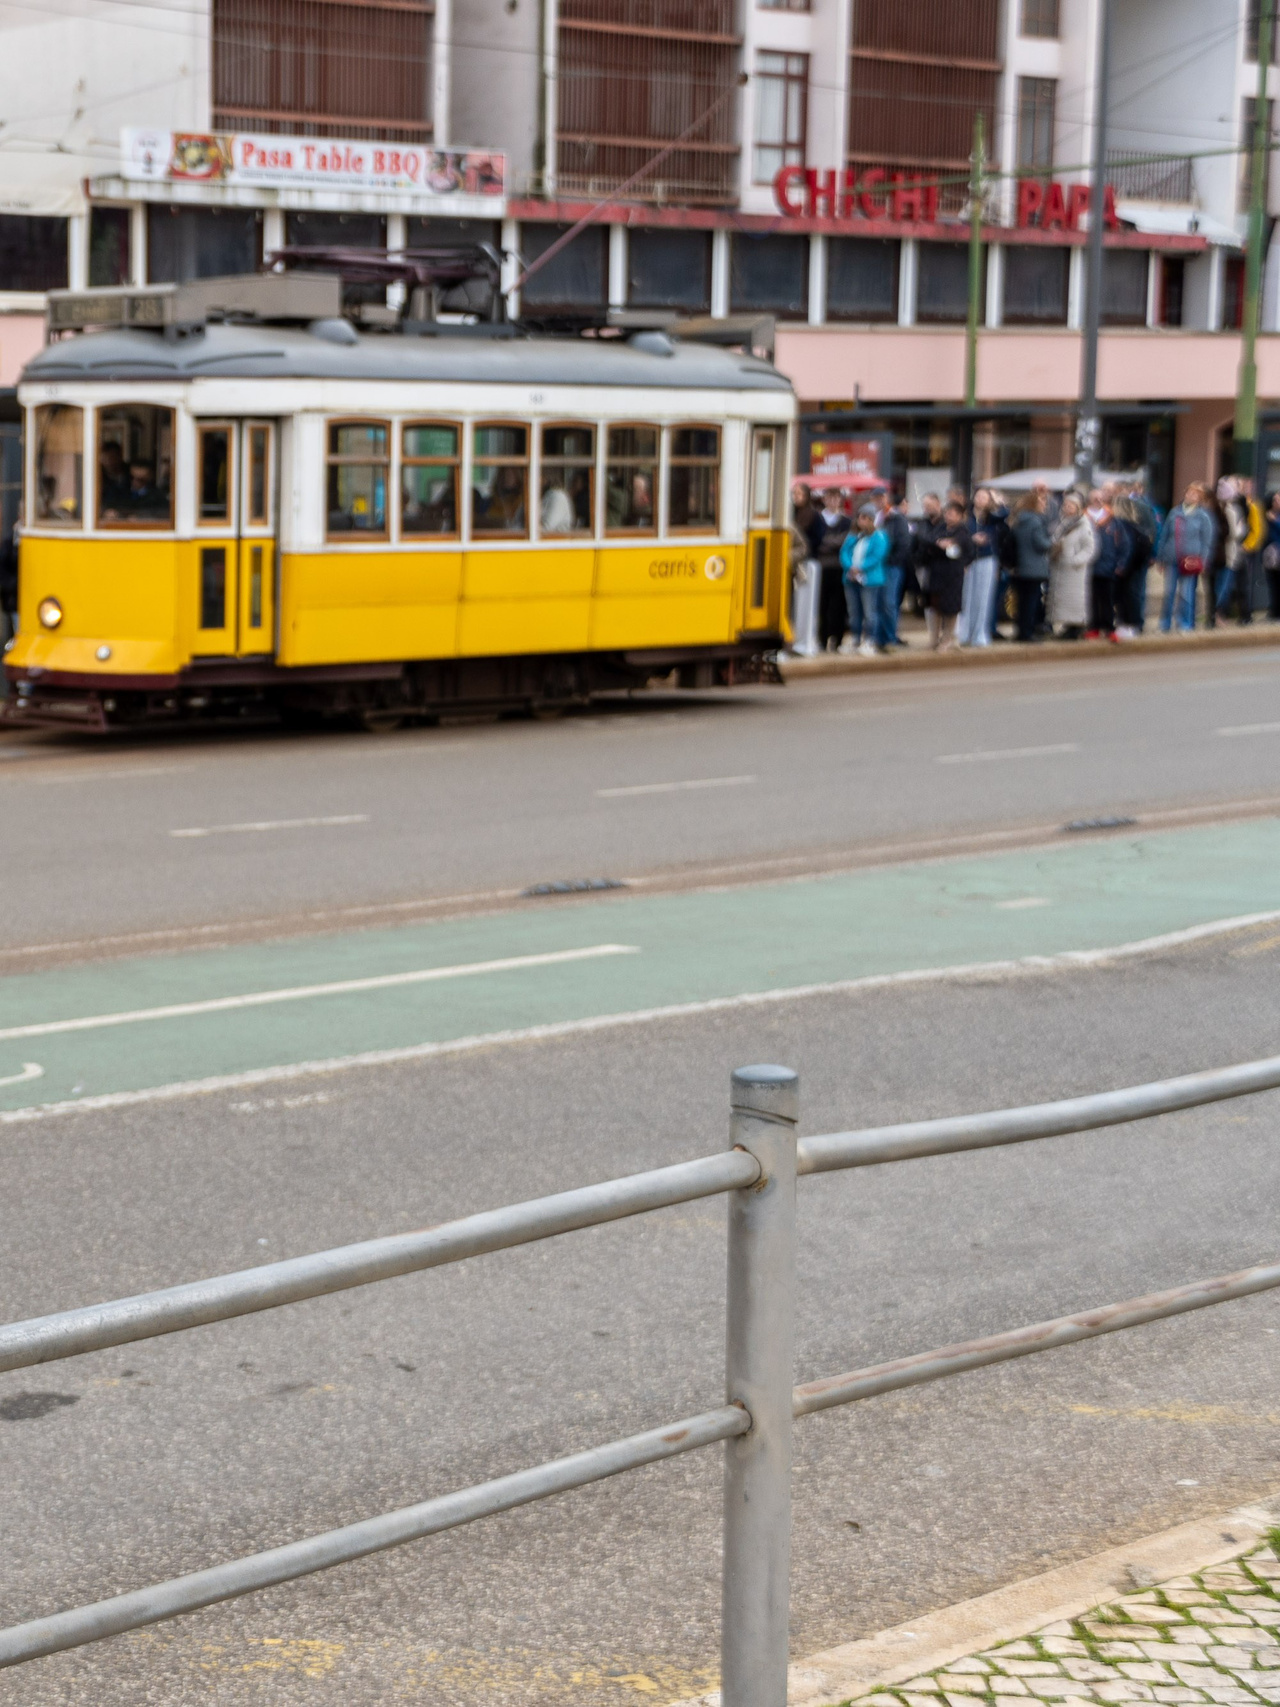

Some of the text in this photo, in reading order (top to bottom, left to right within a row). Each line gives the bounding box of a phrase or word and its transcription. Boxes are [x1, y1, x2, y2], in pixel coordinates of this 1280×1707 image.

[242, 141, 293, 169] Pasa
[301, 144, 363, 173] Table
[373, 150, 419, 183] BBQ
[774, 165, 939, 221] CHICHI
[648, 553, 698, 578] carris
